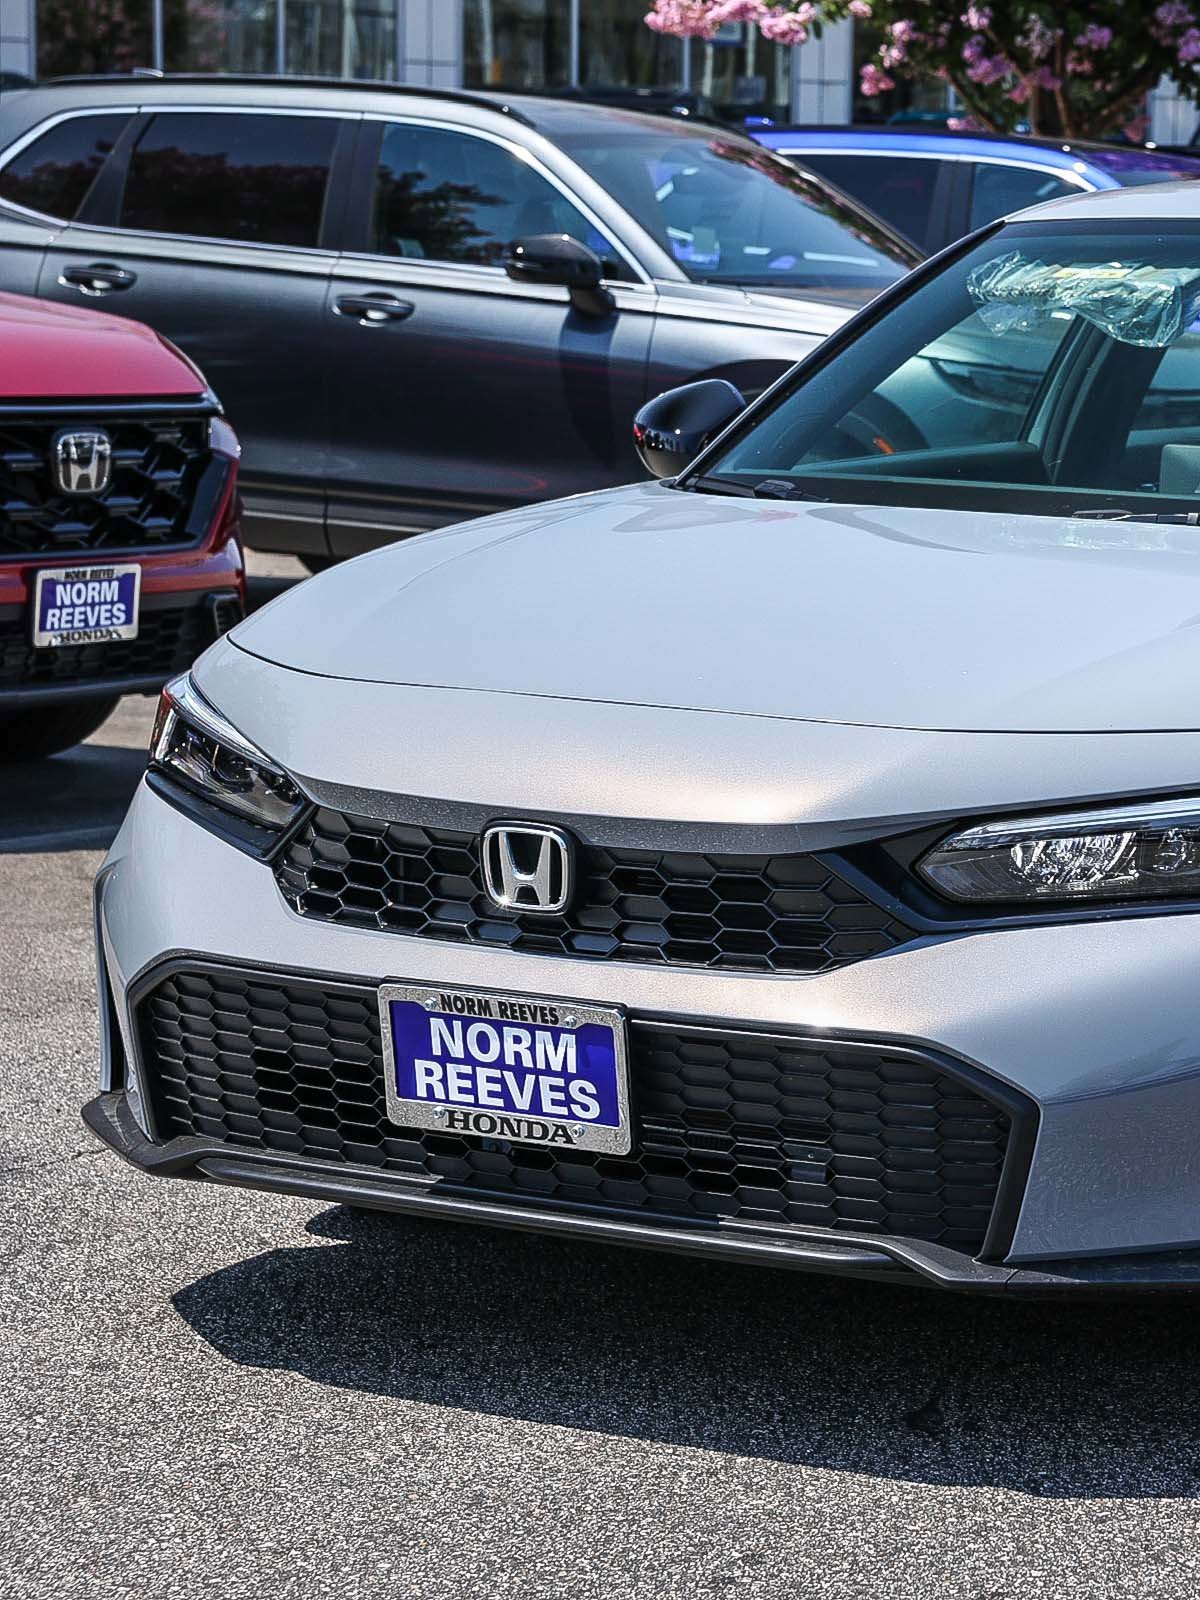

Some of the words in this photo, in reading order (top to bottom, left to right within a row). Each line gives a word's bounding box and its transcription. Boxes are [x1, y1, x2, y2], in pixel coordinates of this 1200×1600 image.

[56, 580, 119, 606] NORM
[46, 603, 126, 630] REEVES
[53, 628, 122, 642] HONDA
[440, 993, 493, 1018] NORM
[497, 1000, 560, 1026] REEVES
[429, 1017, 577, 1074] NORM
[414, 1058, 601, 1120] REEVES
[444, 1108, 577, 1145] HONDA
